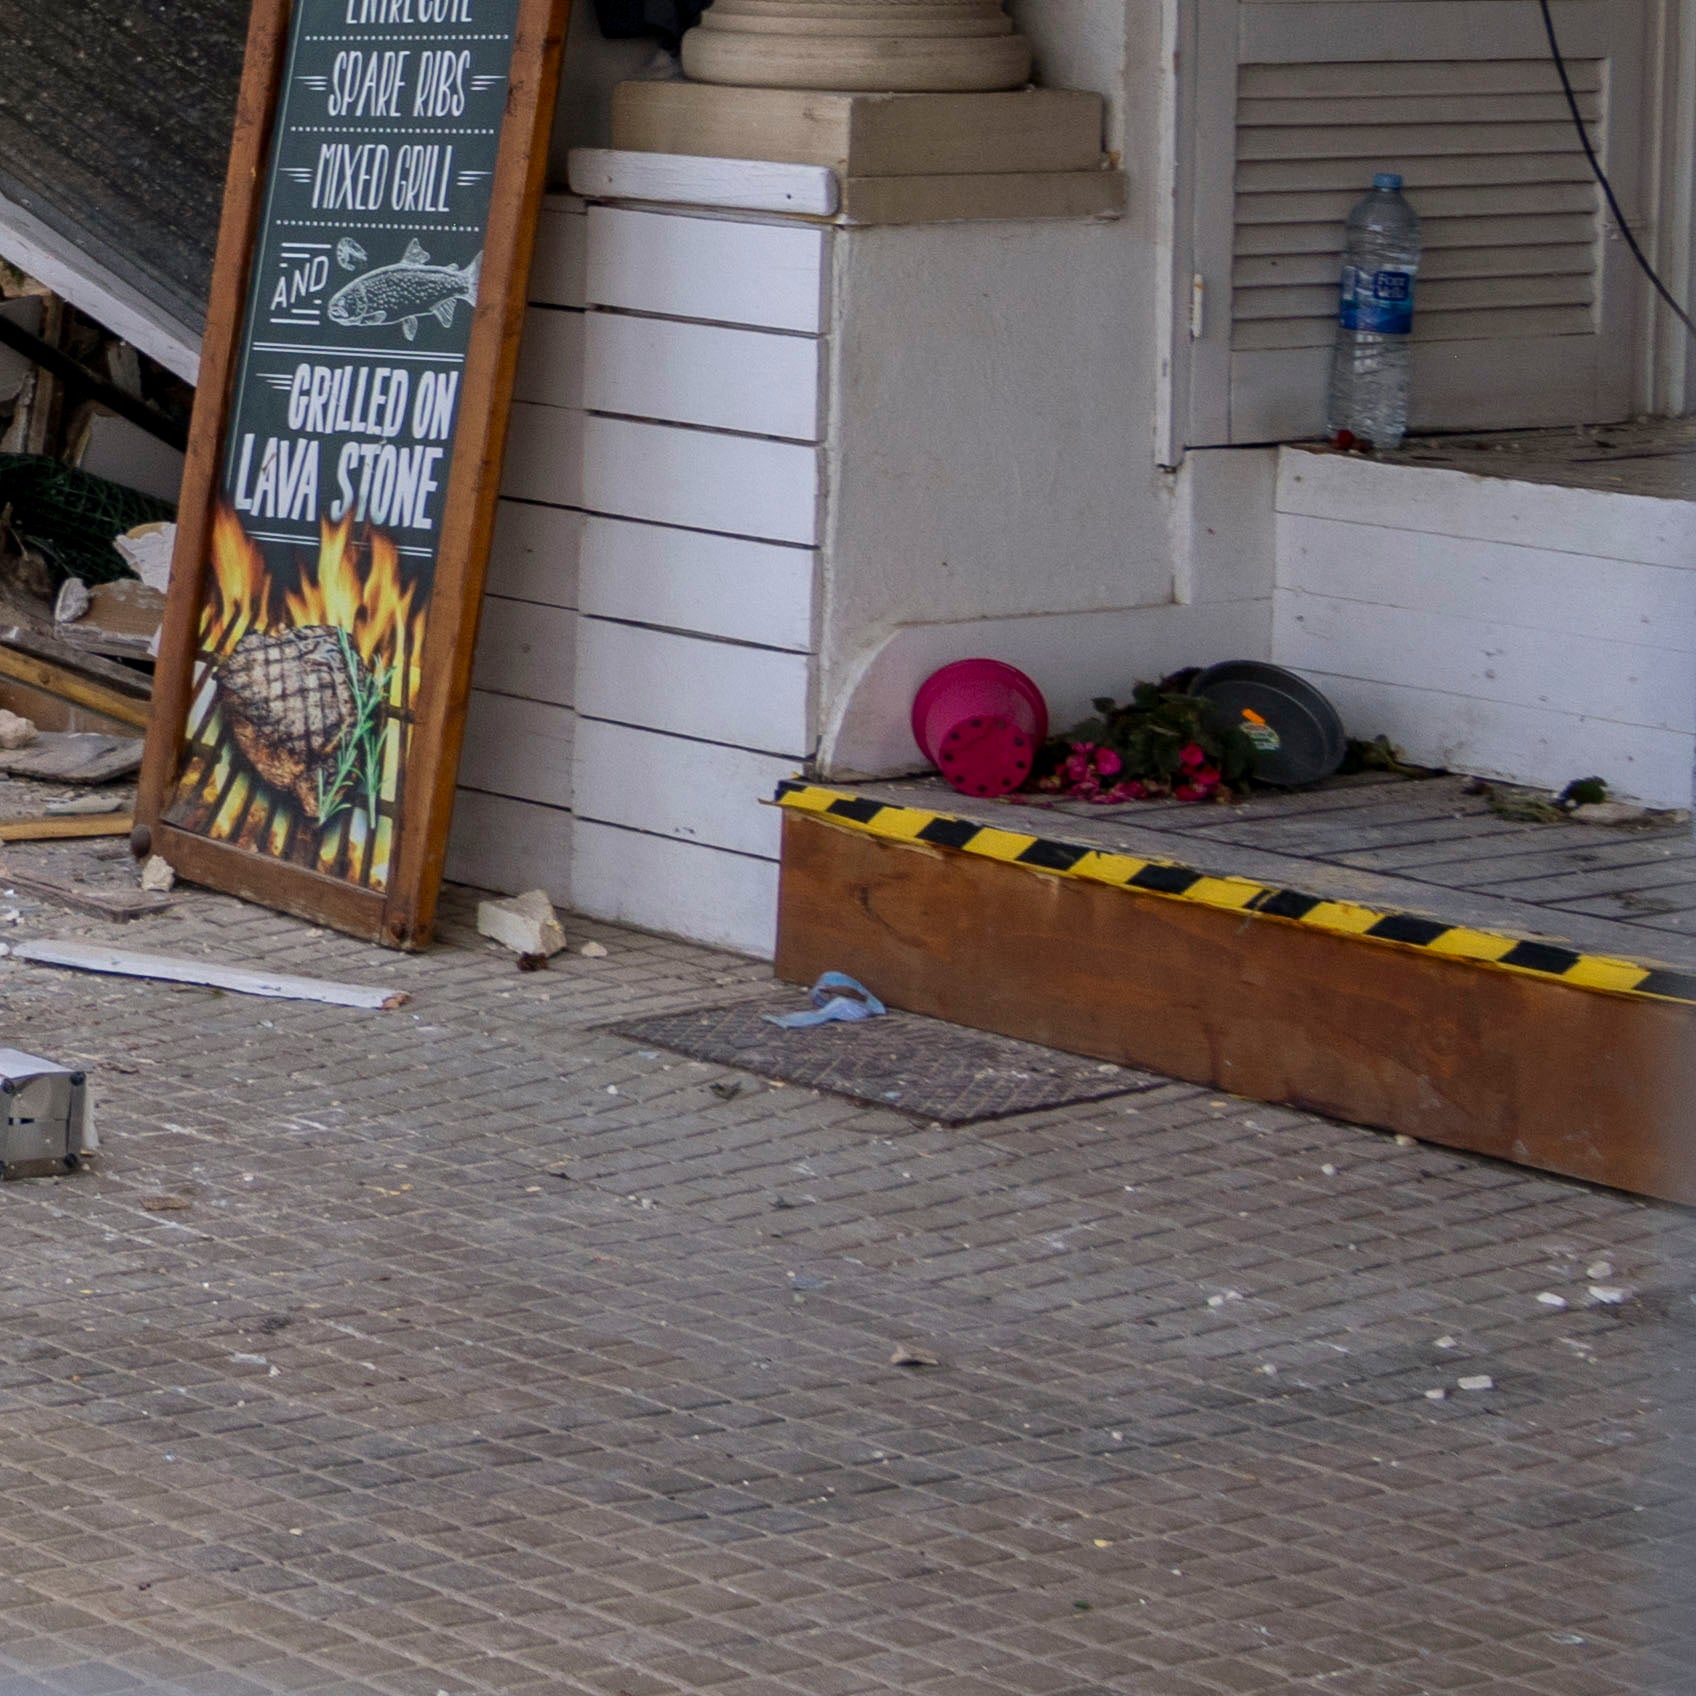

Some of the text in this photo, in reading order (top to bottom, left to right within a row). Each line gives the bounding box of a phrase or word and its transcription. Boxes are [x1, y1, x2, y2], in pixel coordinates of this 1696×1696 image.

[327, 50, 471, 118] SPARE RIBS
[311, 143, 456, 214] MIXED GRILL
[270, 254, 329, 312] AND
[287, 363, 459, 441] GRILLED ON
[234, 433, 445, 530] LAVA STONE
